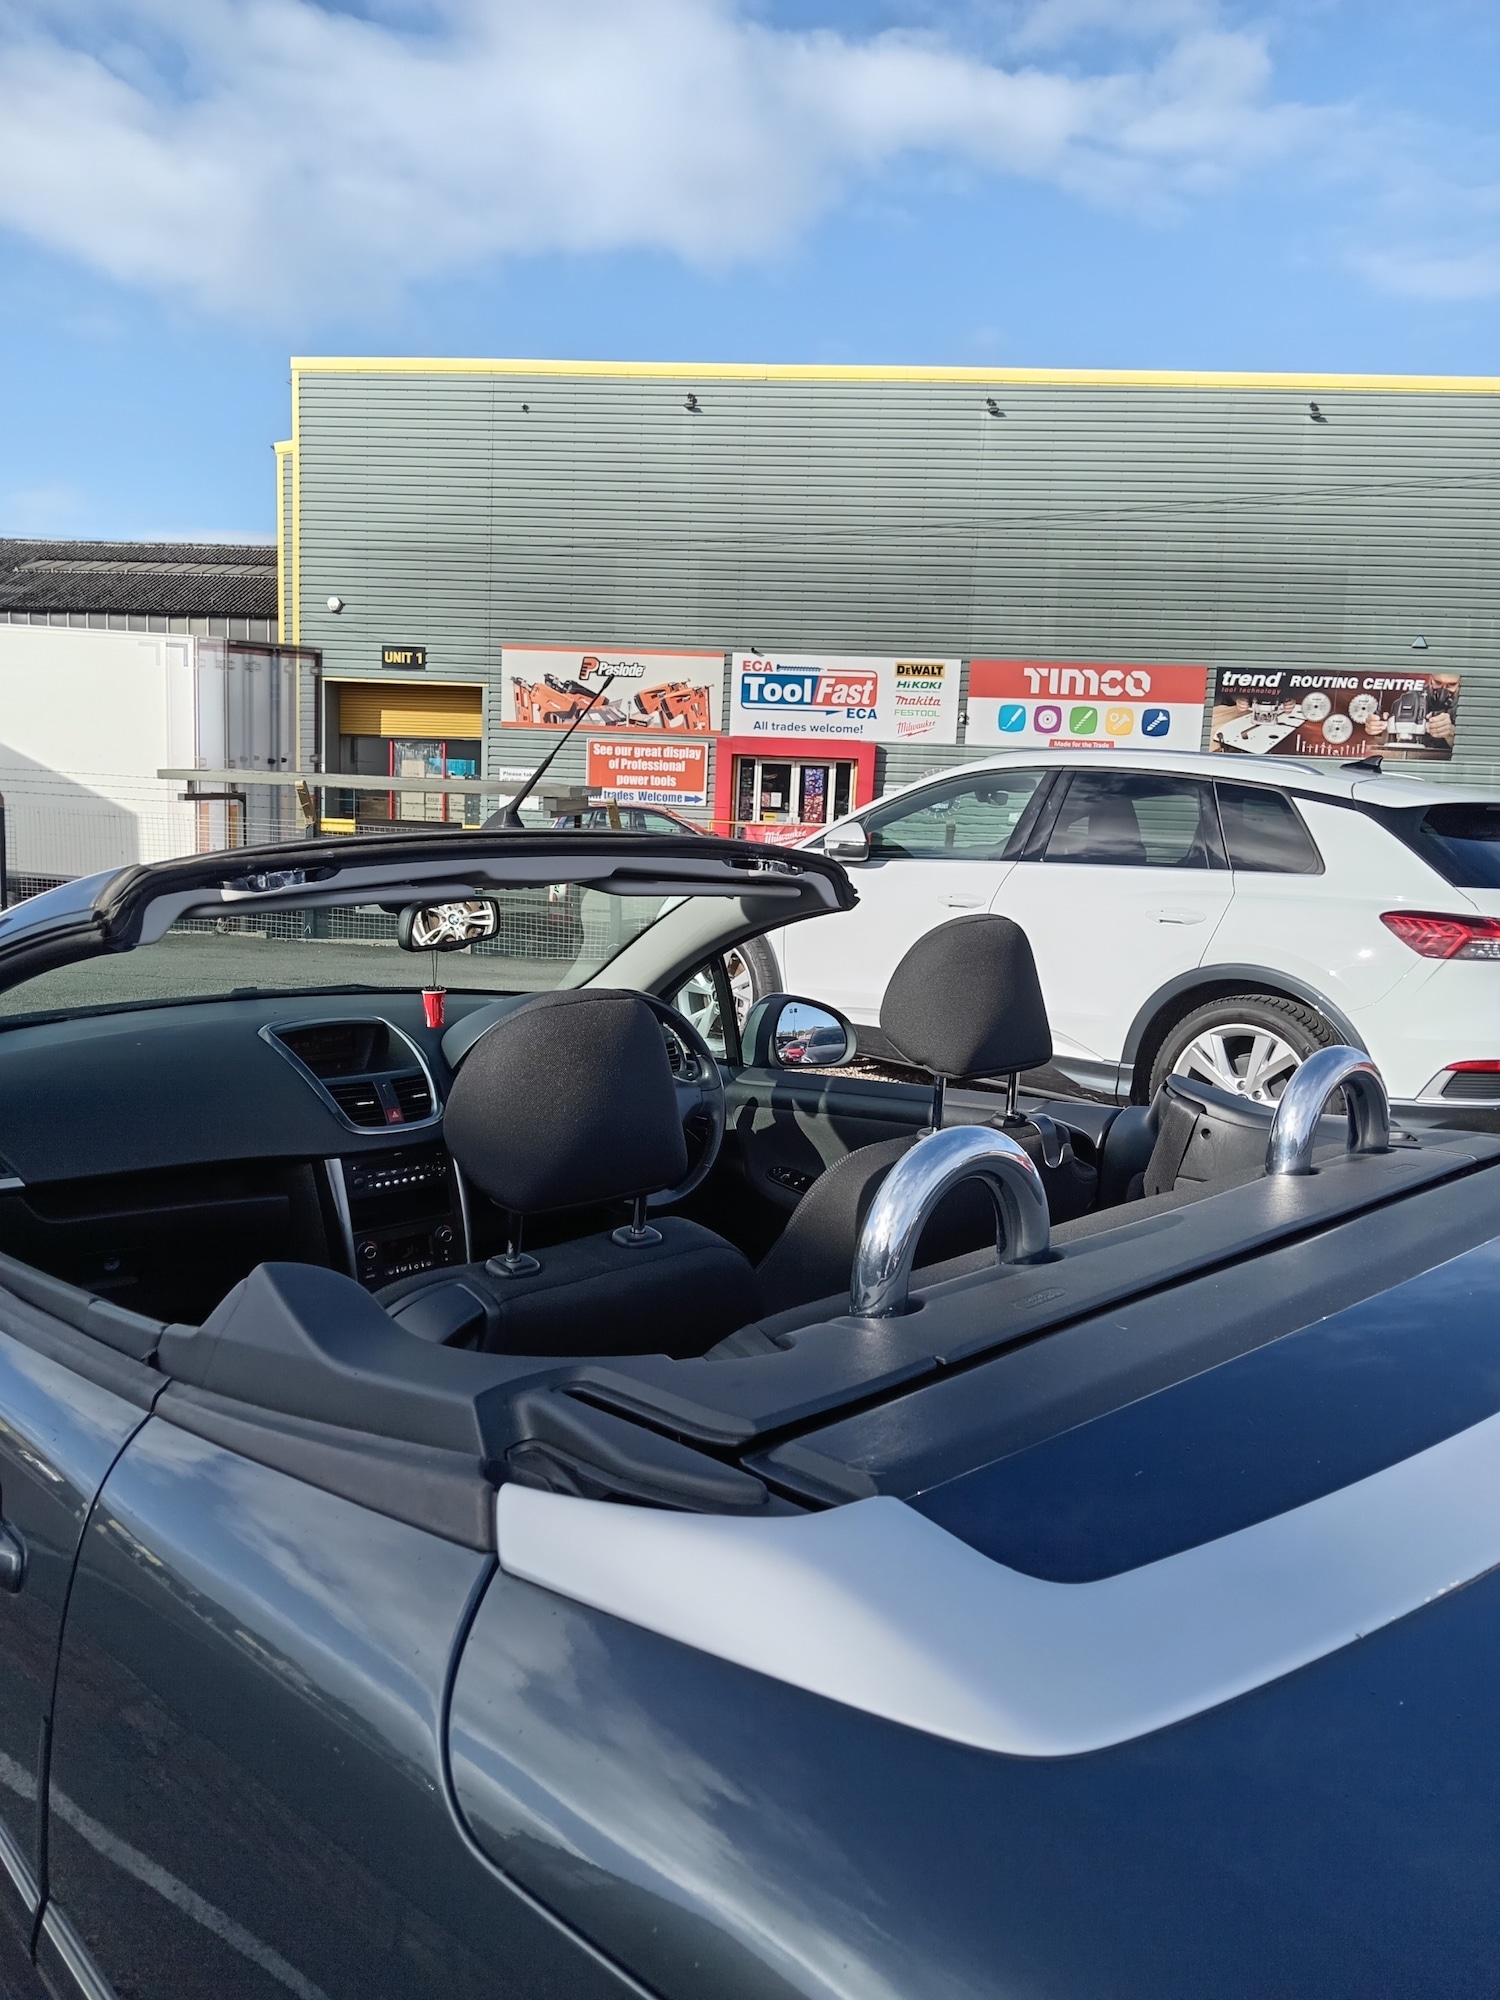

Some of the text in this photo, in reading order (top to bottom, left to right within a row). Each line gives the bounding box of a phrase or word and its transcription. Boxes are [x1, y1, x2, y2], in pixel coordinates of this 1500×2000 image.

[384, 651, 423, 665] UNIT 1
[598, 661, 645, 677] Paslode
[742, 660, 773, 672] ECA
[1023, 667, 1152, 697] TIMCO
[1221, 671, 1426, 691] trend ROUTING CENTRE
[846, 708, 878, 719] ECA
[894, 709, 940, 718] FESTOOL
[753, 721, 864, 734] All trades welcome!
[593, 743, 702, 760] See our great display
[608, 758, 686, 772] of Professional
[616, 774, 677, 787] power tools
[603, 790, 634, 801] trades
[638, 791, 683, 803] Welcome
